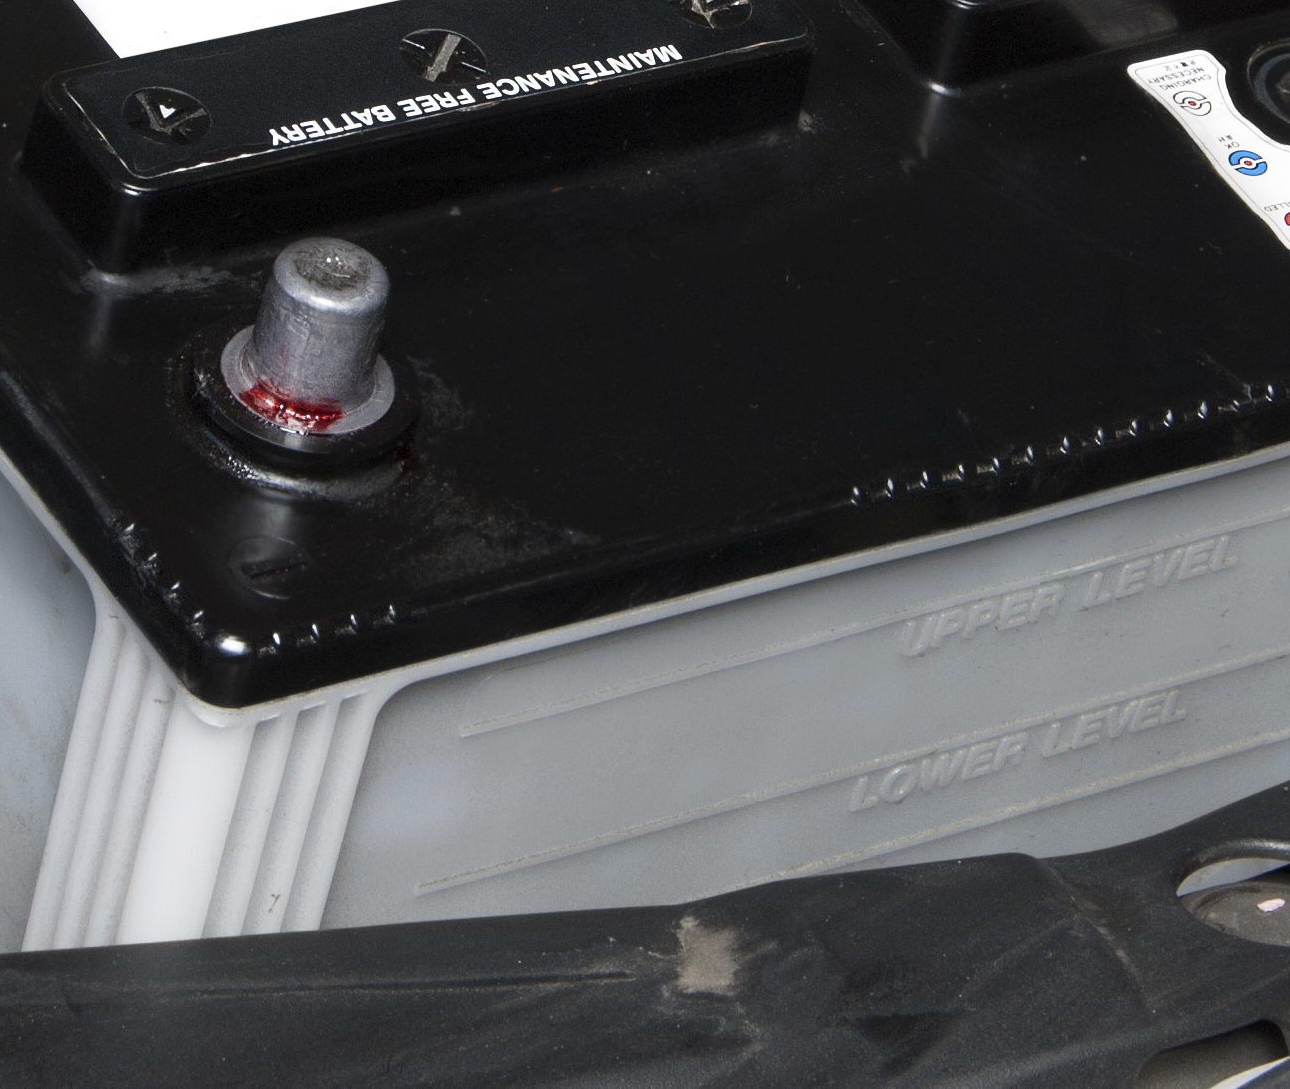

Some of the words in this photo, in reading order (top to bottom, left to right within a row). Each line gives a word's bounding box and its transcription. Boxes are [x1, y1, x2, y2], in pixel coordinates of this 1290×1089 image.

[477, 44, 683, 99] MAINTENANCE
[1146, 66, 1205, 84] NECESSARY
[1160, 73, 1212, 90] CHARGING
[397, 88, 476, 117] FREE
[269, 104, 397, 146] BATTERY
[1226, 141, 1240, 149] OK
[902, 581, 1064, 657] UPPER
[1081, 535, 1238, 608] LEVEL
[851, 731, 1029, 812] LOWER
[1042, 689, 1187, 758] LEVEL
